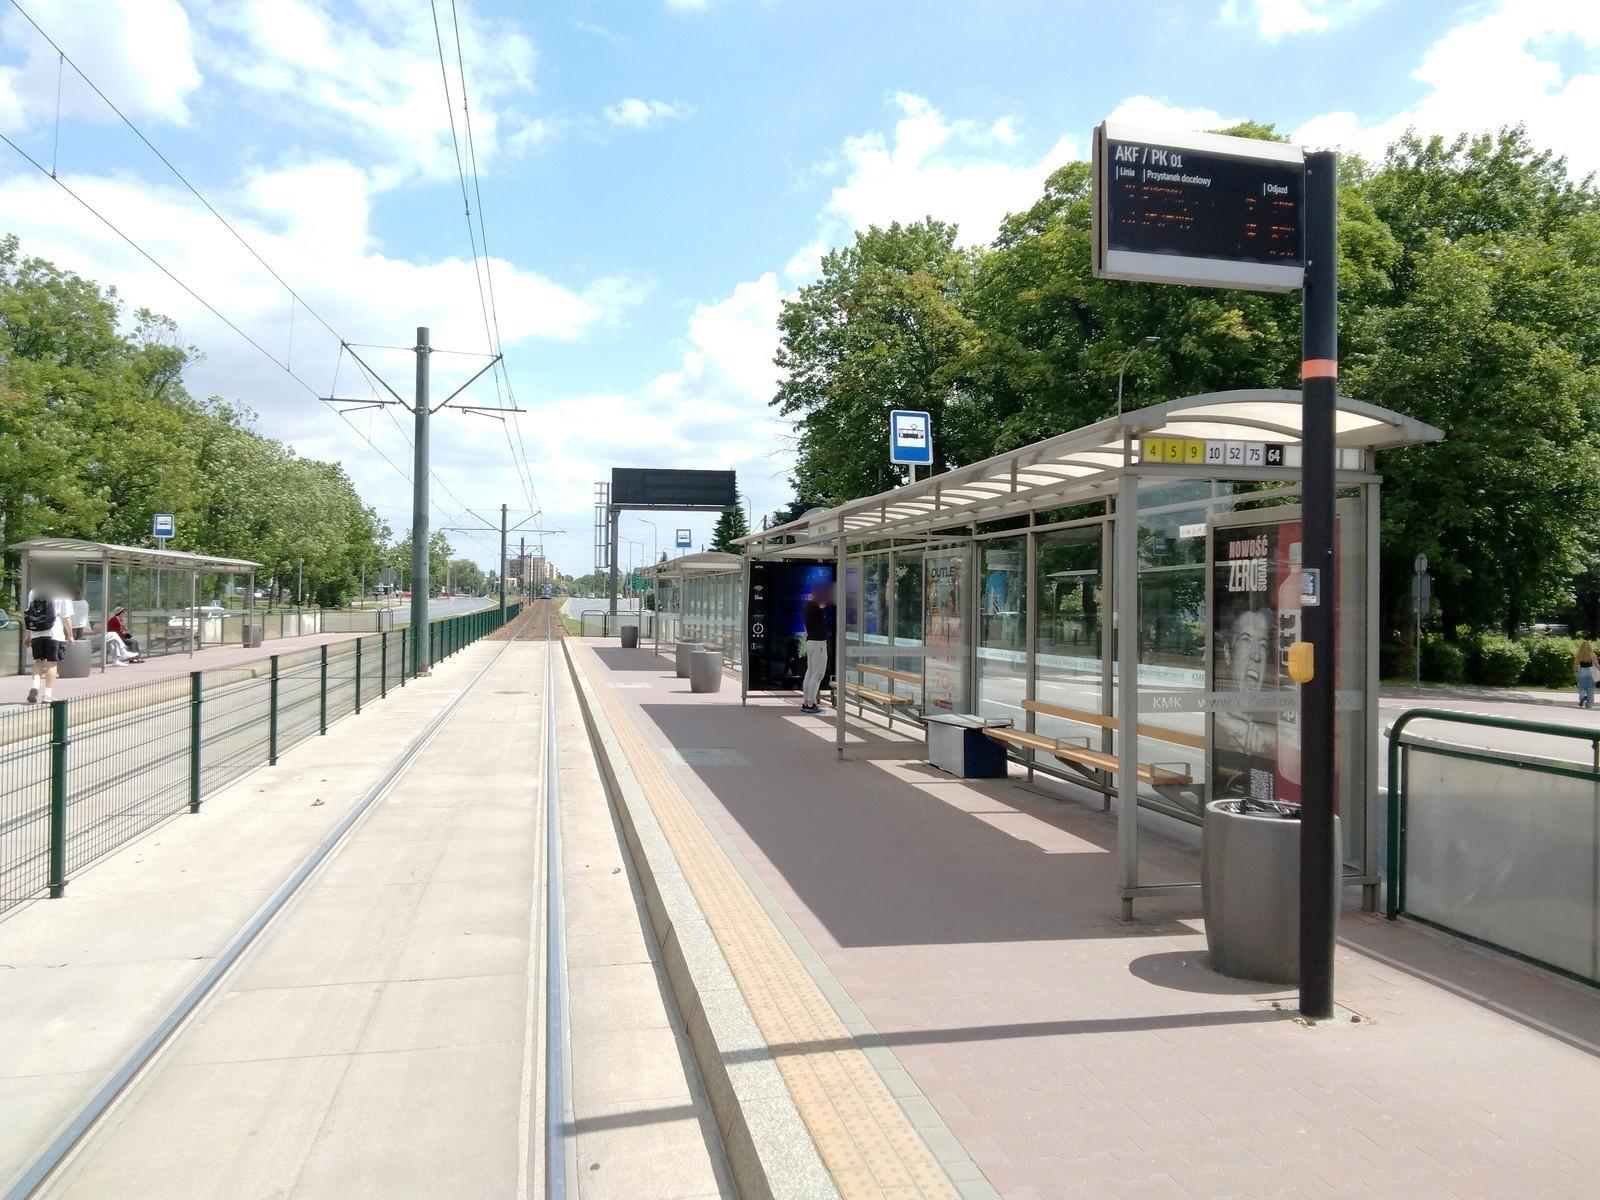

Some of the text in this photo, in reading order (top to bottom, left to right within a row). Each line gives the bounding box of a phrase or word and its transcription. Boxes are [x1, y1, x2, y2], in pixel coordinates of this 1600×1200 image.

[1115, 145, 1183, 168] AKF / PK 01
[1120, 166, 1135, 176] Linia
[1147, 170, 1212, 188] Przystanek docelowy
[1267, 183, 1288, 195] Odjazd
[1150, 445, 1280, 462] 4 5 9 10 52 75 64
[1229, 534, 1268, 558] NOWOŚĆ
[1228, 559, 1258, 592] ZERO
[1258, 558, 1268, 592] SUGAR
[1153, 697, 1183, 708] KMK
